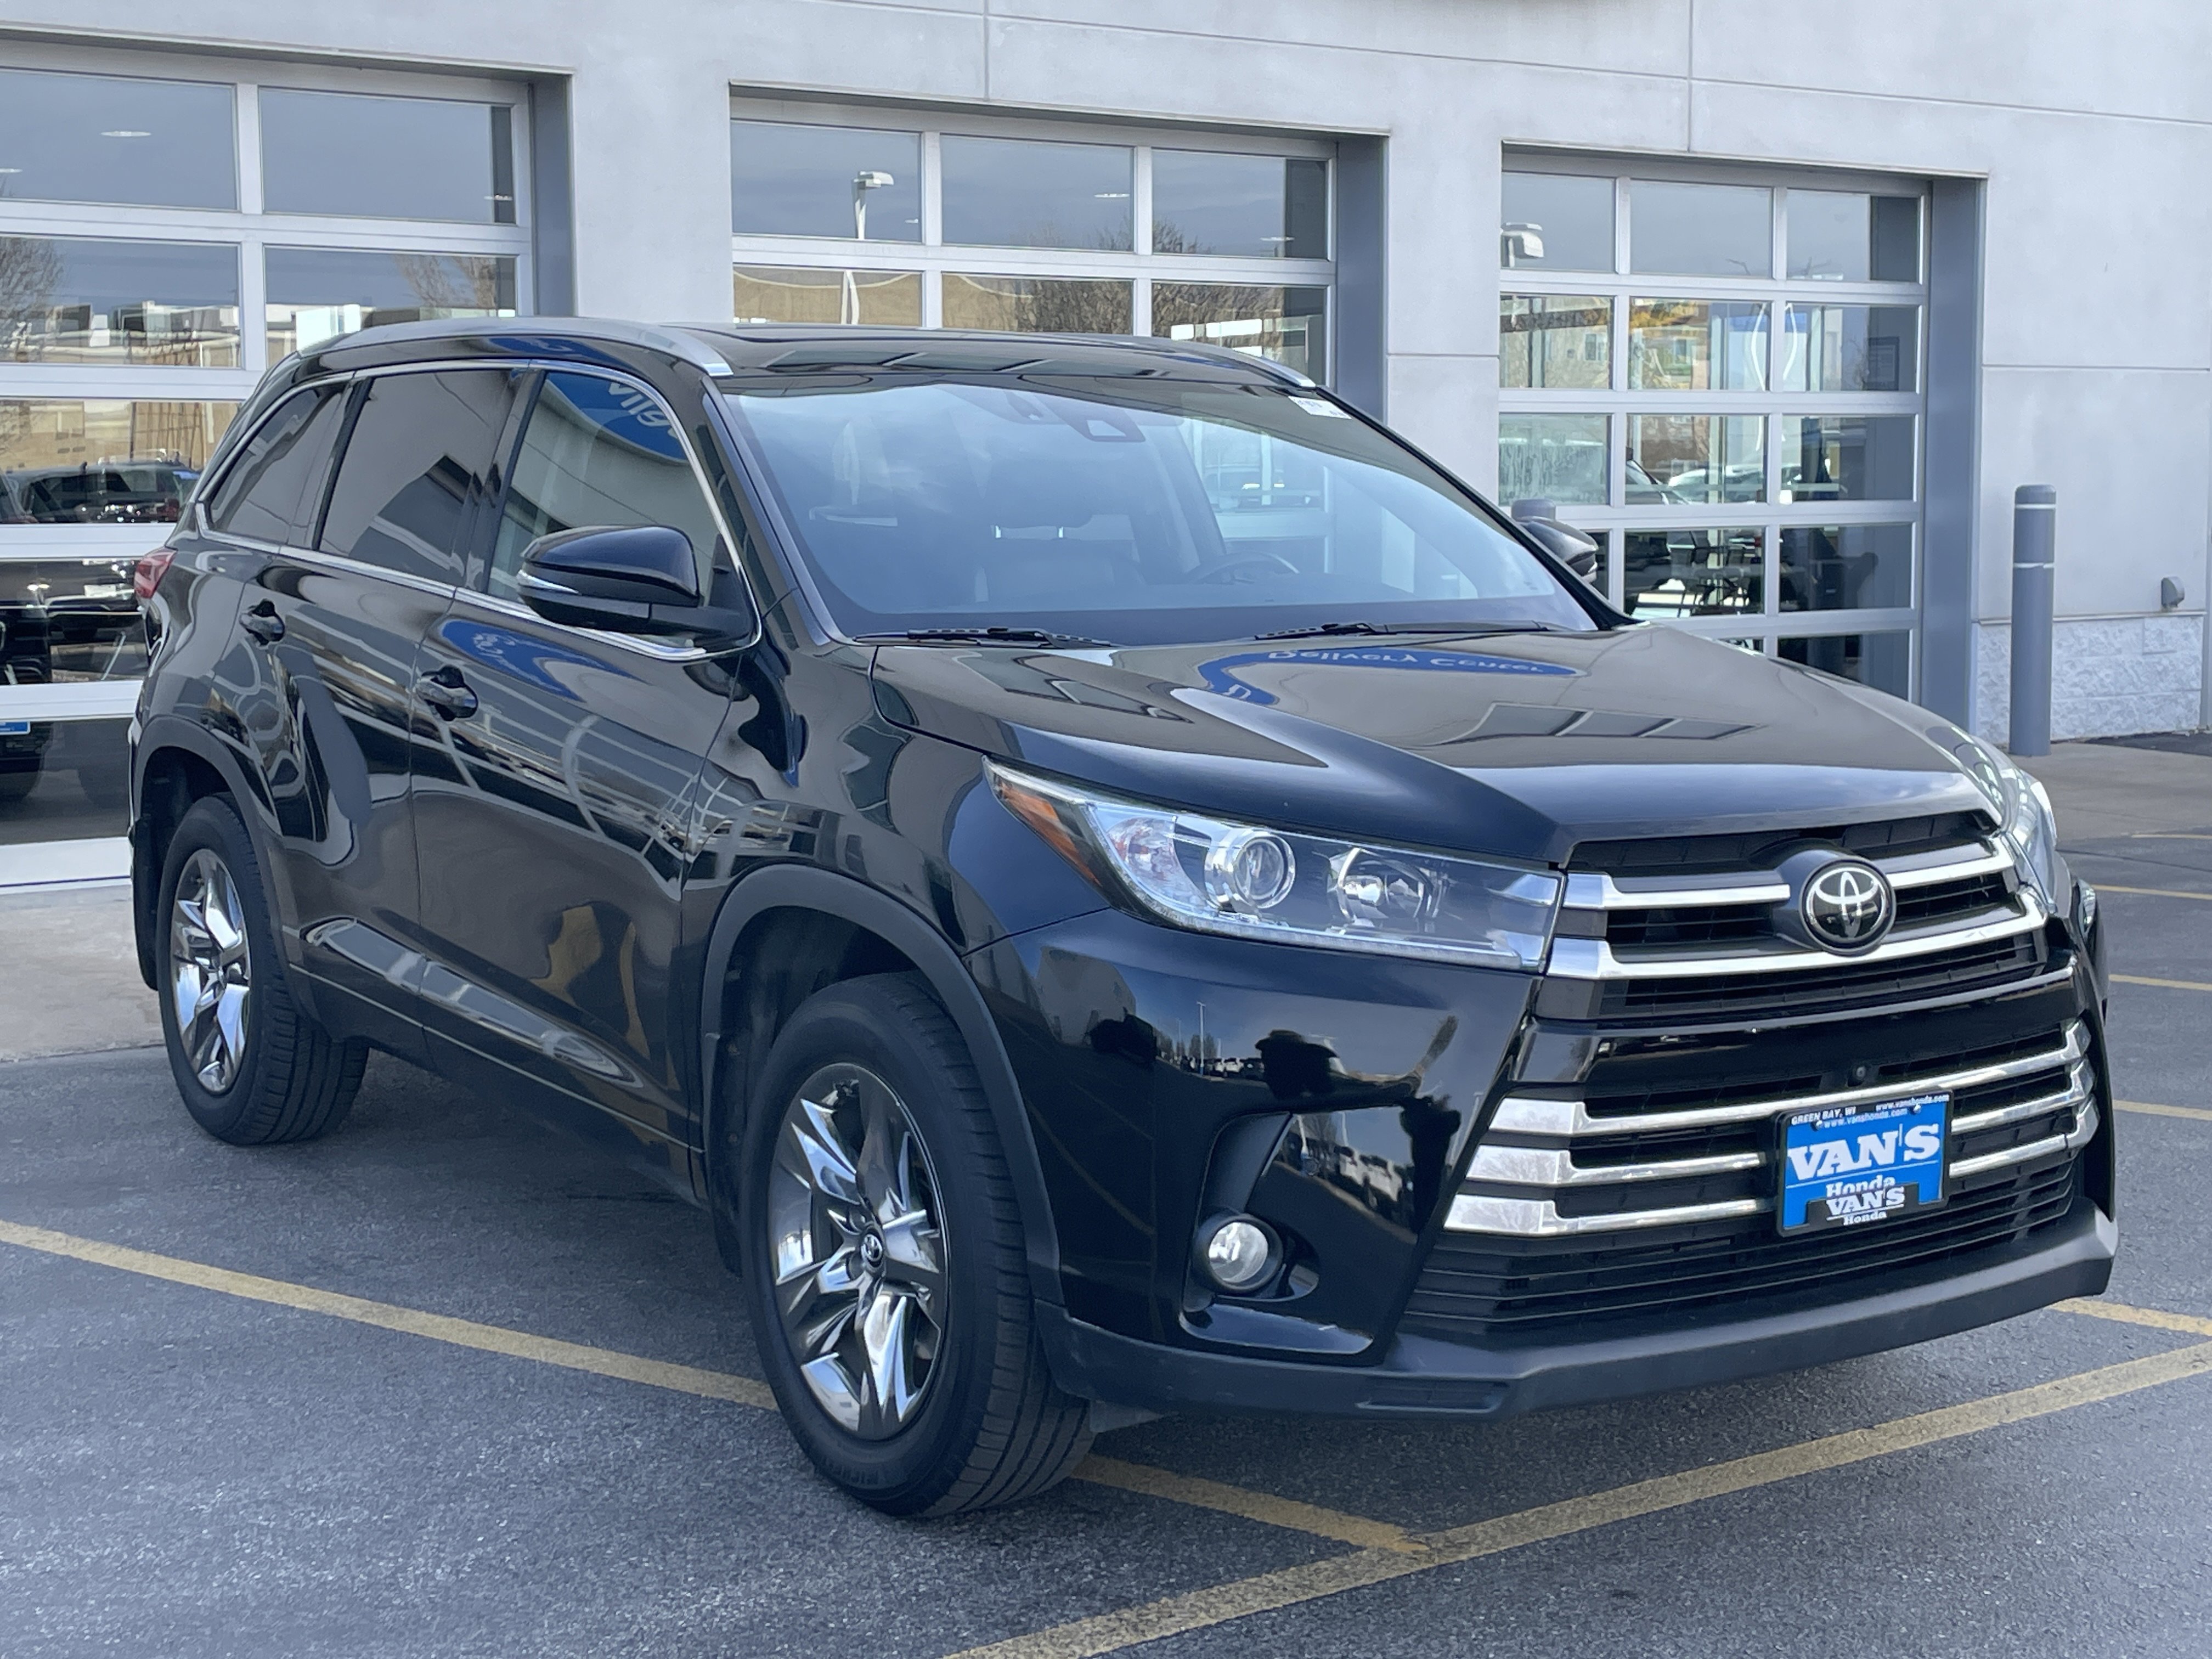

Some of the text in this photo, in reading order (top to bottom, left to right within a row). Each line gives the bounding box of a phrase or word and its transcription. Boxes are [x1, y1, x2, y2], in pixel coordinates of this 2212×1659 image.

[1791, 1107, 1856, 1125] GREEN BAY, WI
[1787, 1123, 1940, 1180] VAN'S
[1826, 1175, 1896, 1197] Honda
[1826, 1186, 1905, 1216] VAN'S
[1843, 1210, 1887, 1226] Honda
